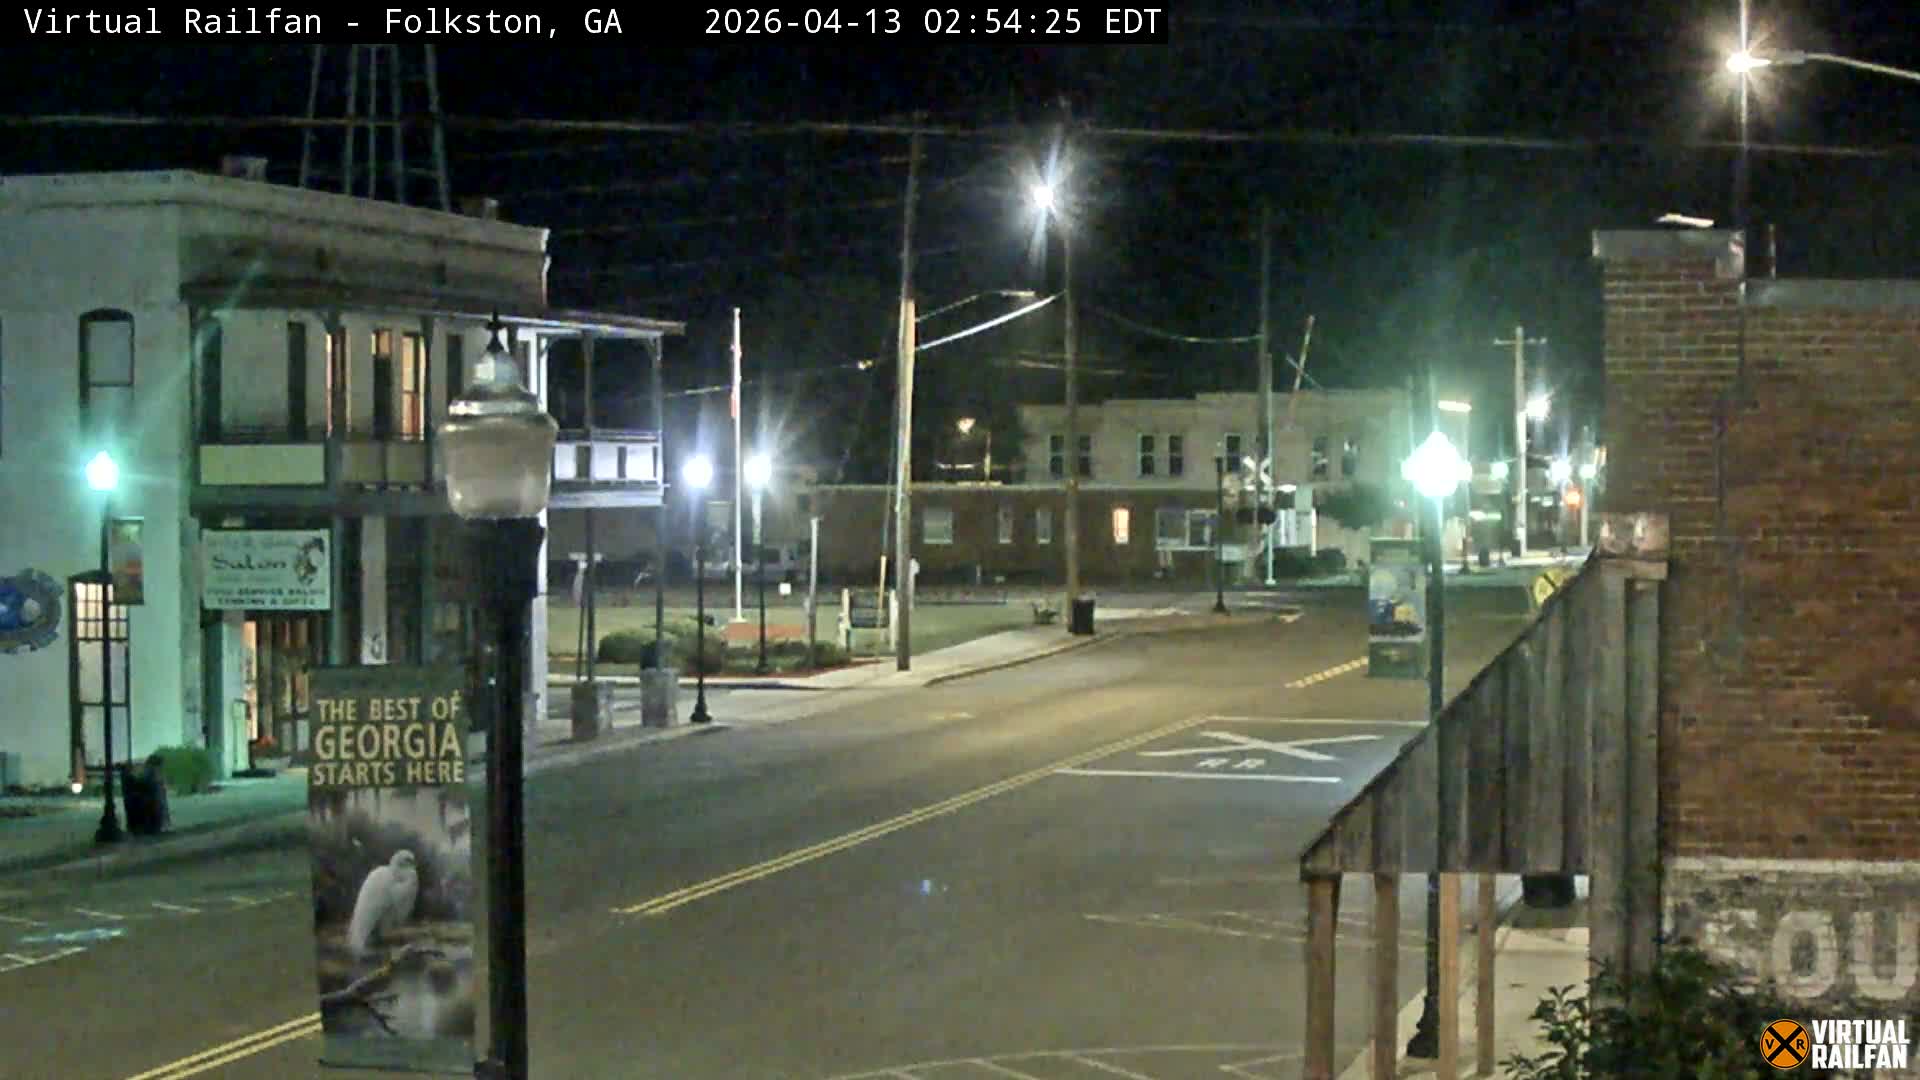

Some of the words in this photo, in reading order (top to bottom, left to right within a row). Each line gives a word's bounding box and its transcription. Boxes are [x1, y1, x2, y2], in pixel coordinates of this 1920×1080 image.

[211, 552, 288, 571] Salon
[316, 698, 358, 722] THE
[369, 697, 421, 721] BEST
[431, 695, 461, 720] OF
[314, 722, 464, 761] GEORGIA
[312, 761, 396, 786] STARTS
[406, 760, 465, 784] HERE
